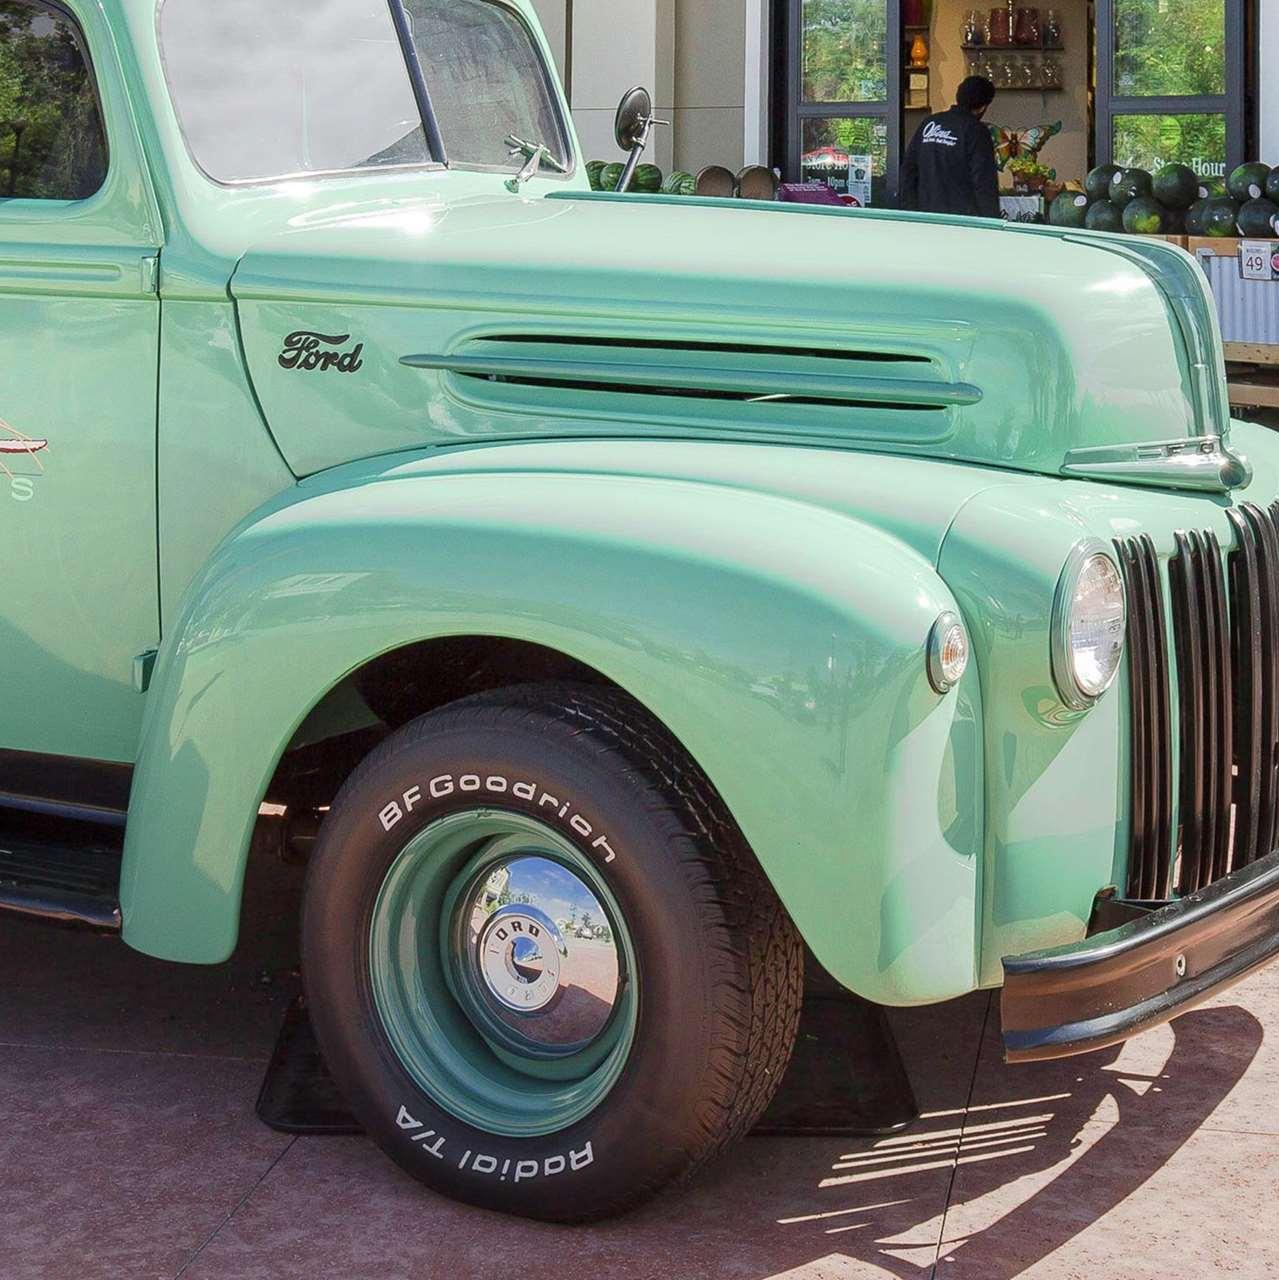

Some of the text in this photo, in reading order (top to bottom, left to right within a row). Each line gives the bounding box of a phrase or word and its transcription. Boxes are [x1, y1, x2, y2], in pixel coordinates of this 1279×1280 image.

[278, 330, 364, 373] Ford
[395, 1104, 595, 1182] Radial T/A
